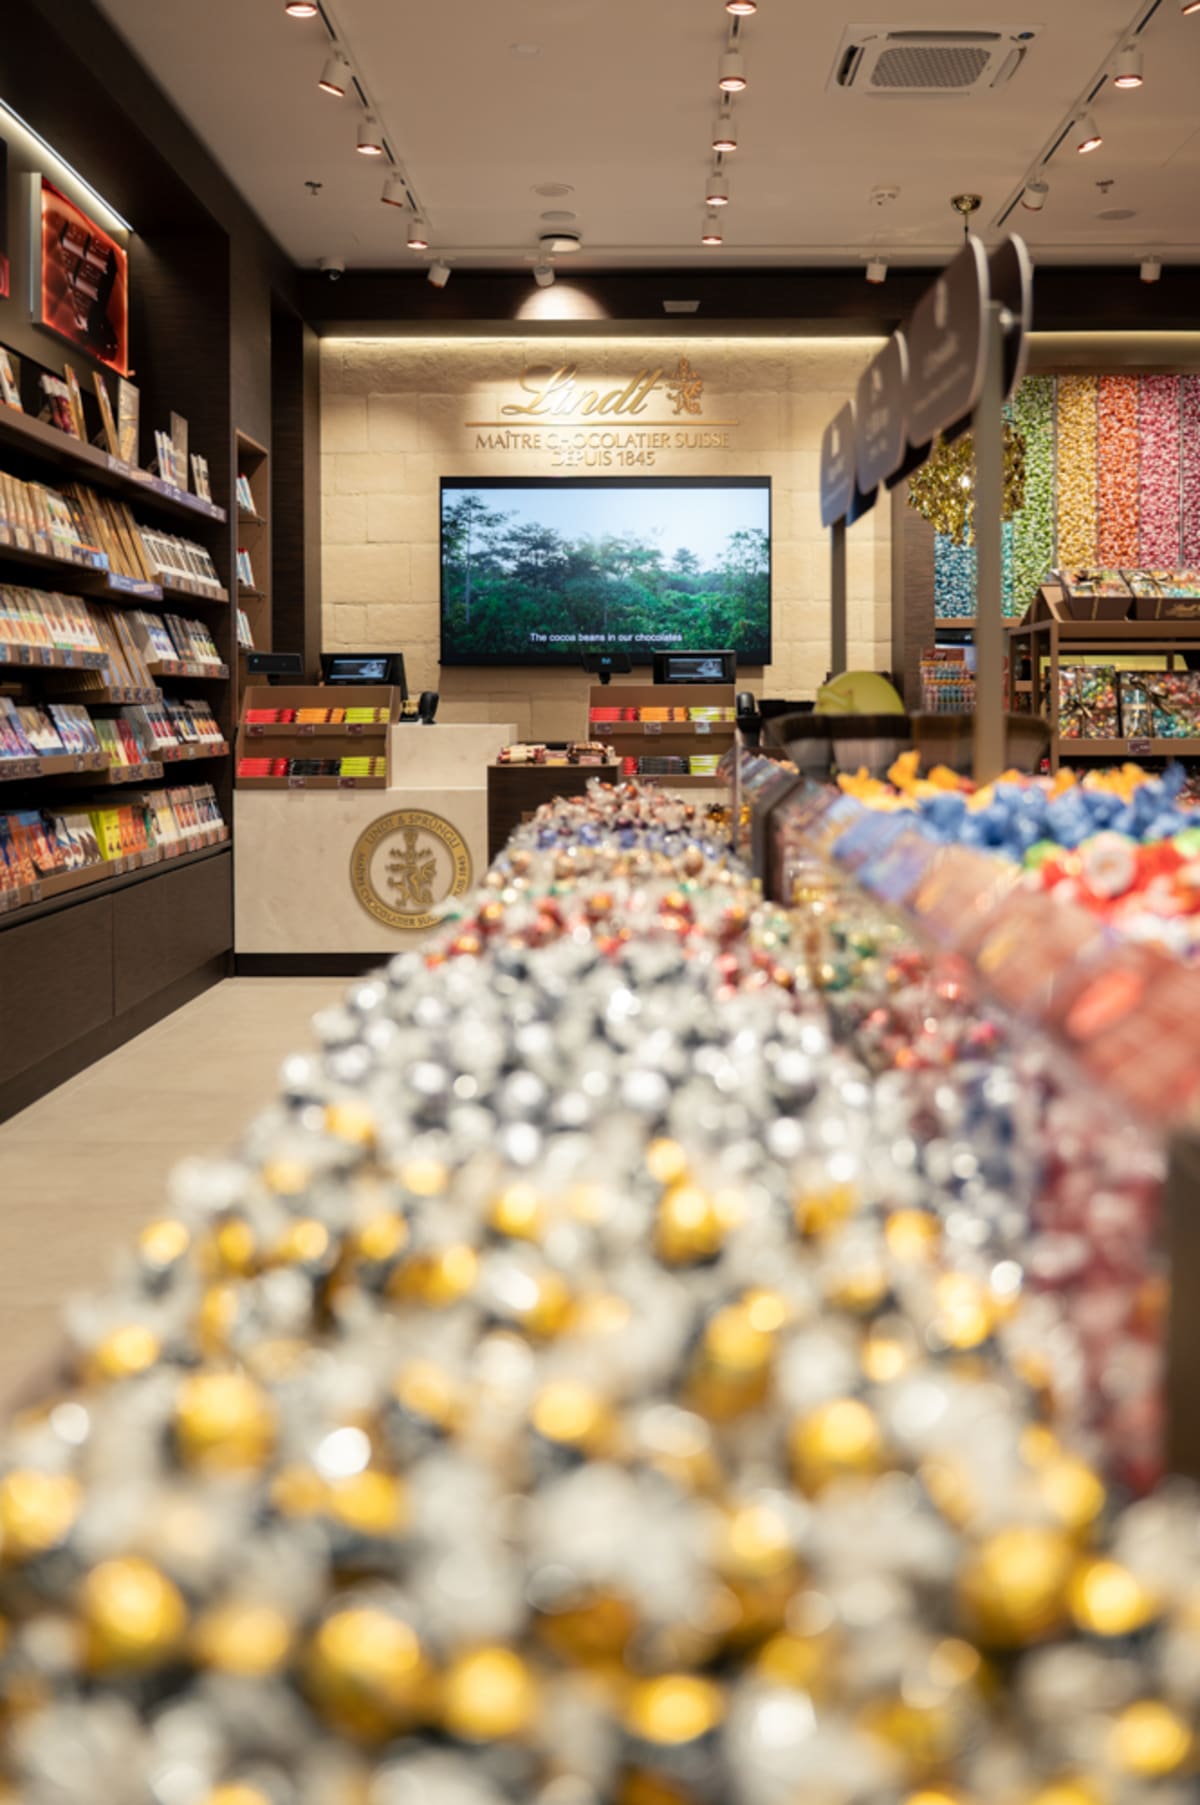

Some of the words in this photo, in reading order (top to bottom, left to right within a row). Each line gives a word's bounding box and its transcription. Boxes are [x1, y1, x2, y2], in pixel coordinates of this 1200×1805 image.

[501, 364, 664, 415] Lindt
[475, 430, 541, 449] MAÎTRE
[675, 432, 730, 449] SUISSE
[616, 451, 655, 466] 1845
[530, 633, 547, 642] The
[549, 633, 576, 642] cocoa
[578, 633, 605, 642] beans
[607, 633, 616, 642] in
[617, 634, 632, 642] our
[634, 633, 682, 642] chocolates
[365, 818, 392, 845] LINDT
